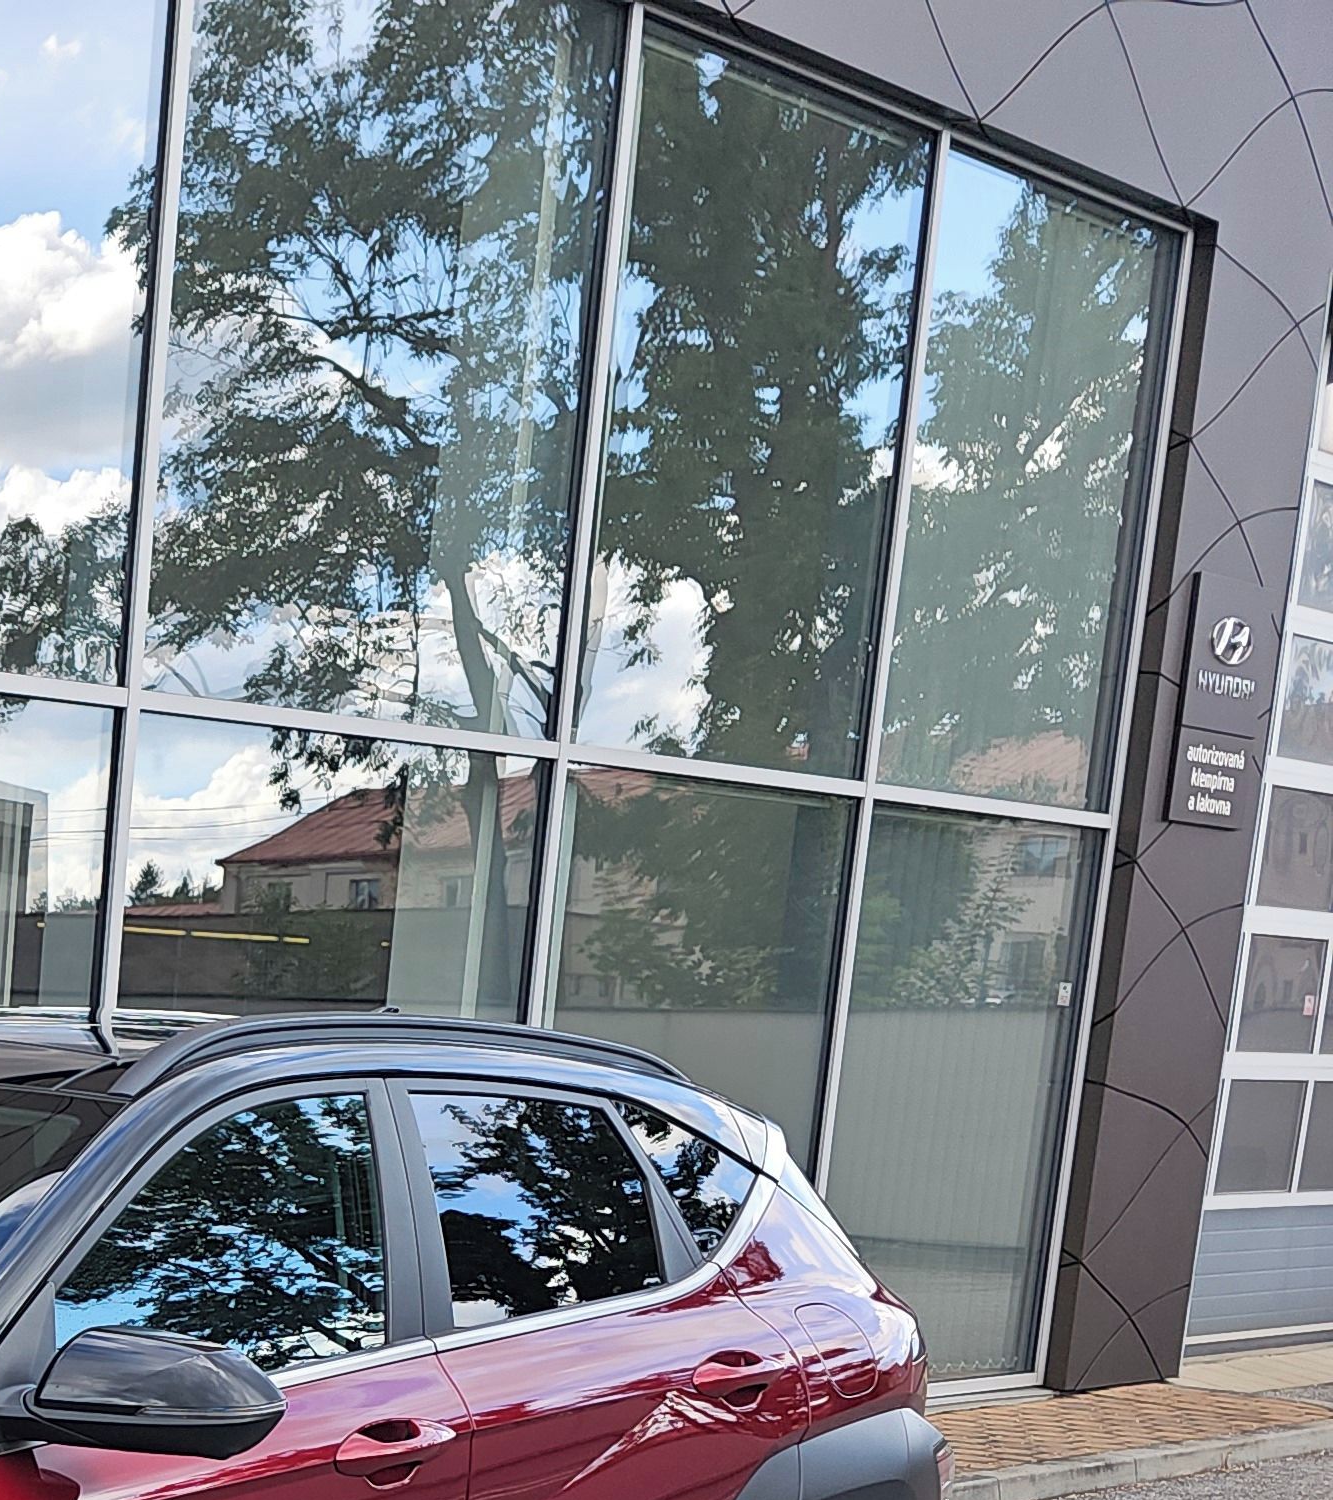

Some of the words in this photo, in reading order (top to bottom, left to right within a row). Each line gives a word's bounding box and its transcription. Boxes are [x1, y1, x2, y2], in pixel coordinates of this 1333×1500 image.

[1198, 669, 1256, 699] HYUNDAI
[1187, 744, 1245, 770] autorizovaná
[1190, 767, 1235, 793] klempírna
[1188, 795, 1195, 811] a
[1196, 792, 1231, 816] lakovna
